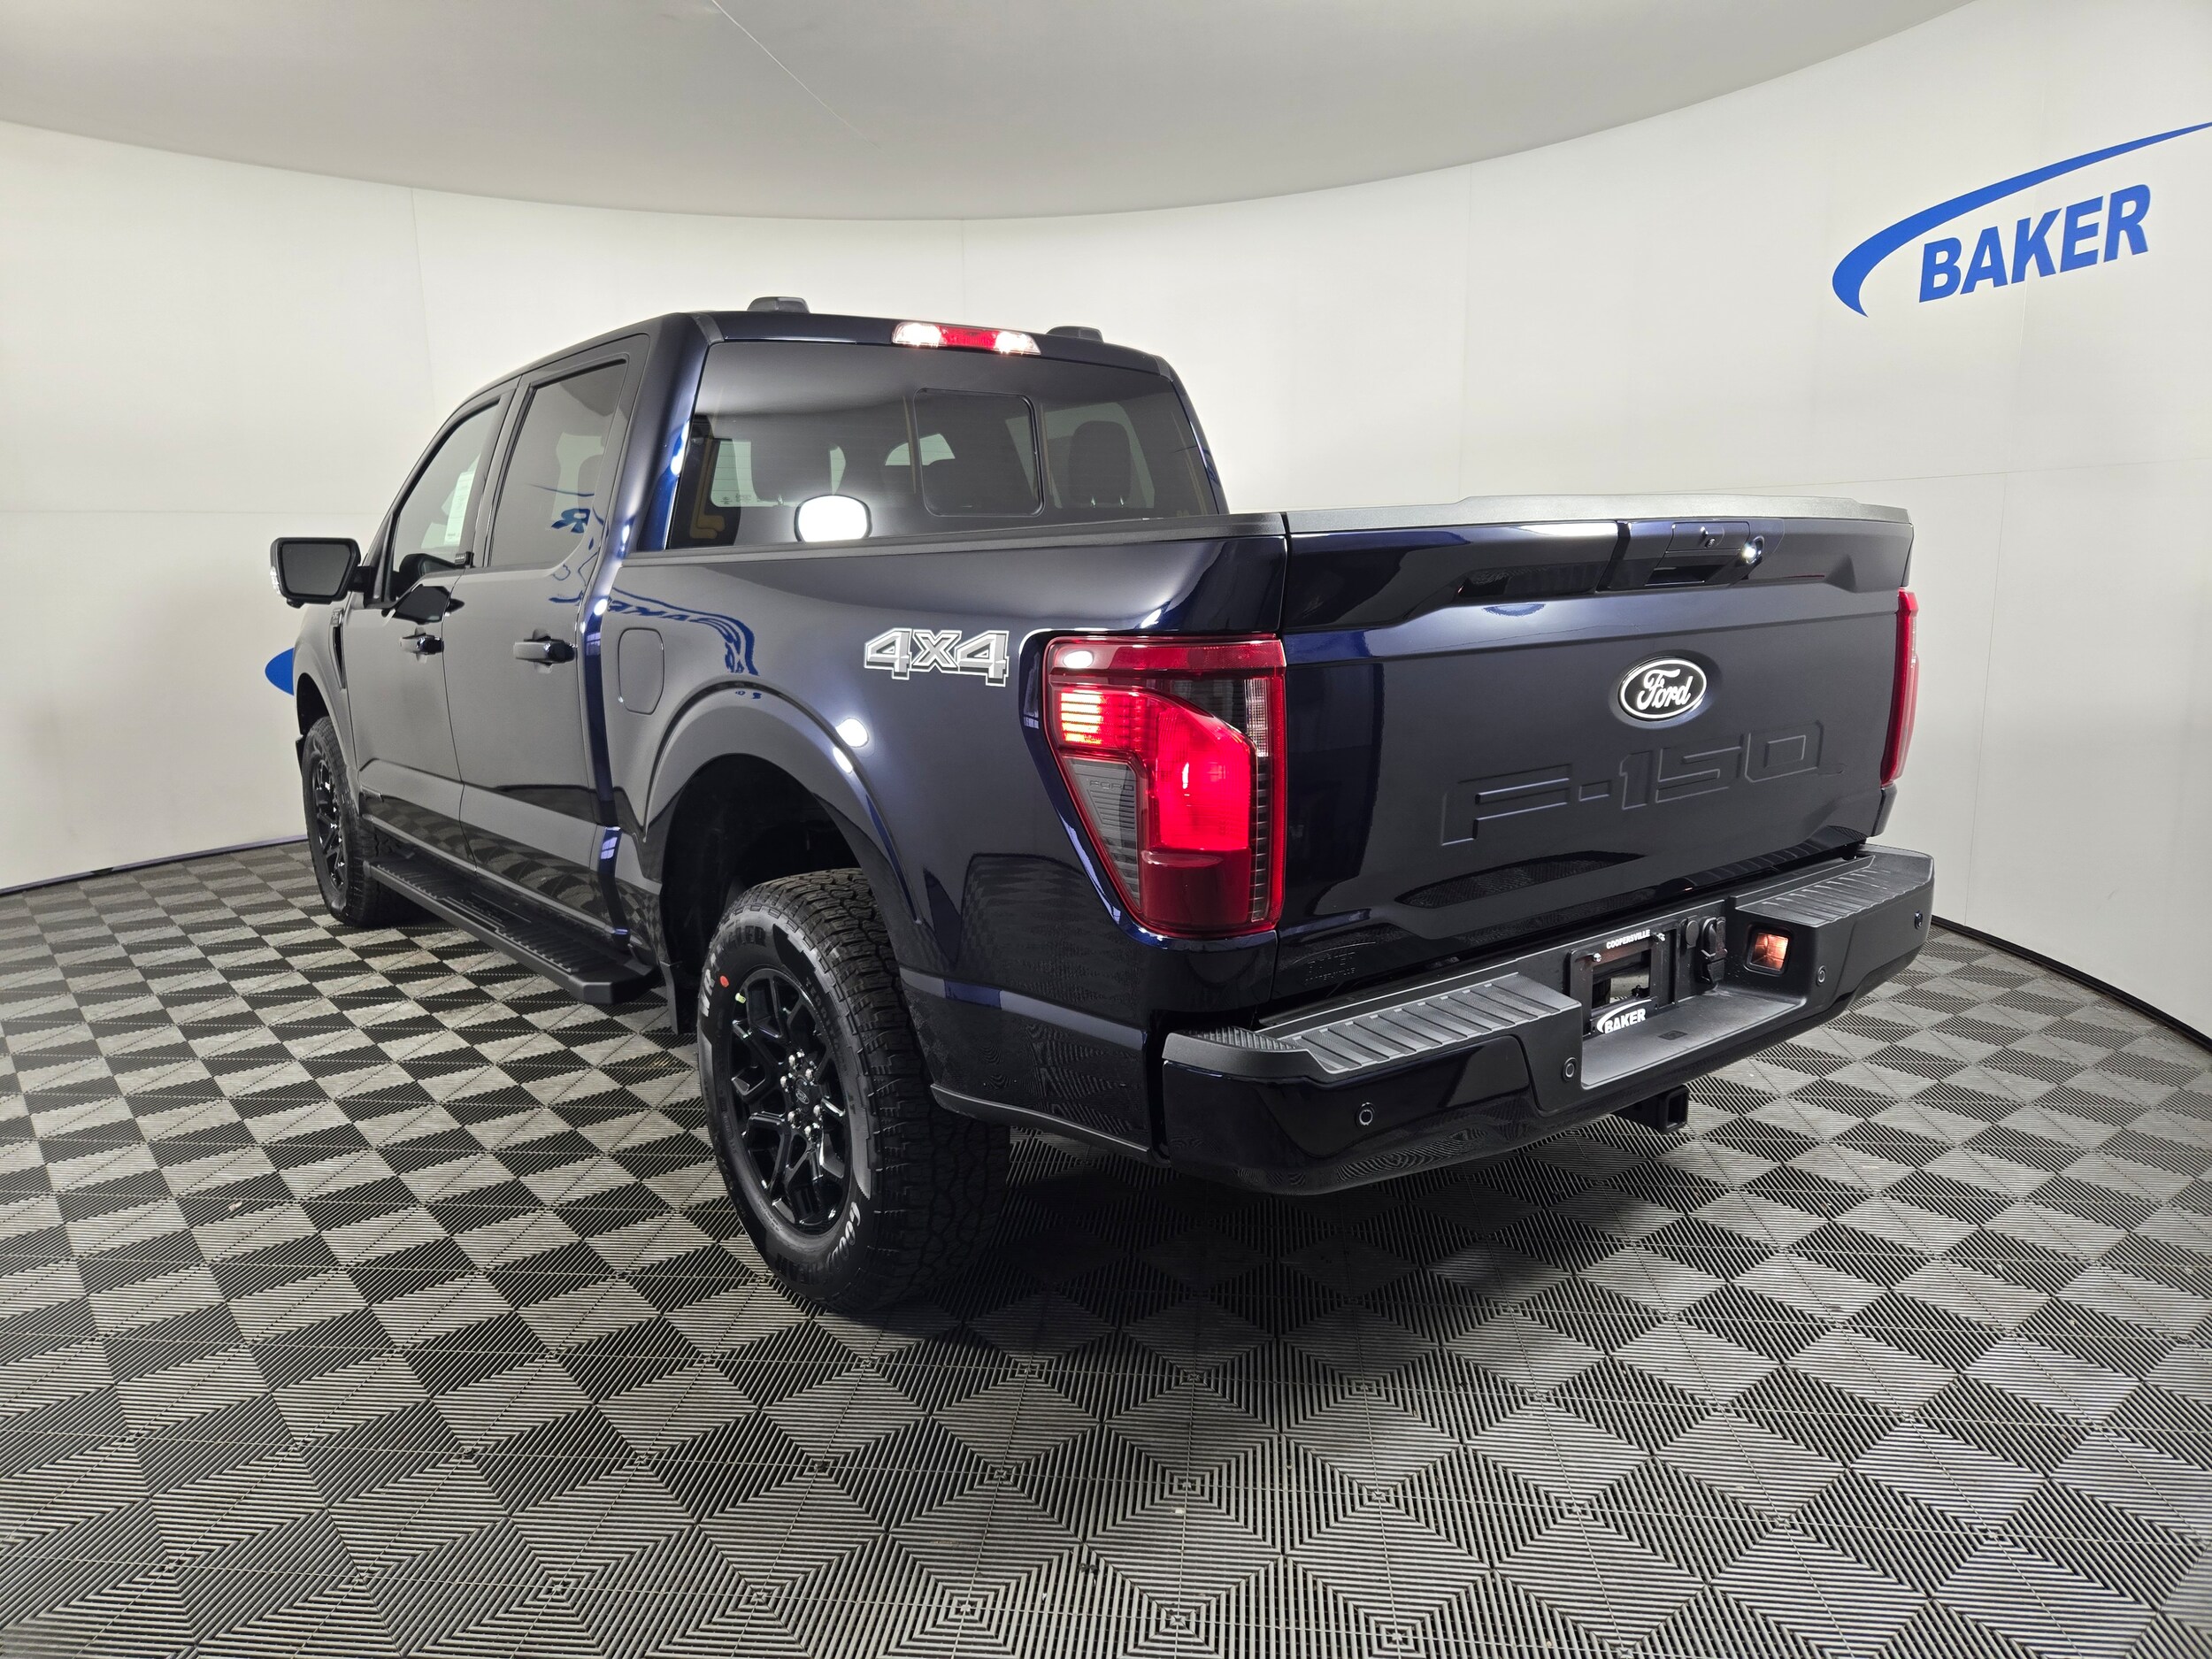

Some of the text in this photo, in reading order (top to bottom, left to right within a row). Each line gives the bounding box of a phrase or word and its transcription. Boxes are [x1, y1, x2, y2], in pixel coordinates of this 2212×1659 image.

[1919, 184, 2151, 303] BAKER
[1636, 668, 1694, 710] Ford
[1440, 720, 1824, 846] F-150
[1606, 929, 1651, 949] COOPERSVILLE
[1604, 1008, 1646, 1034] BAKER
